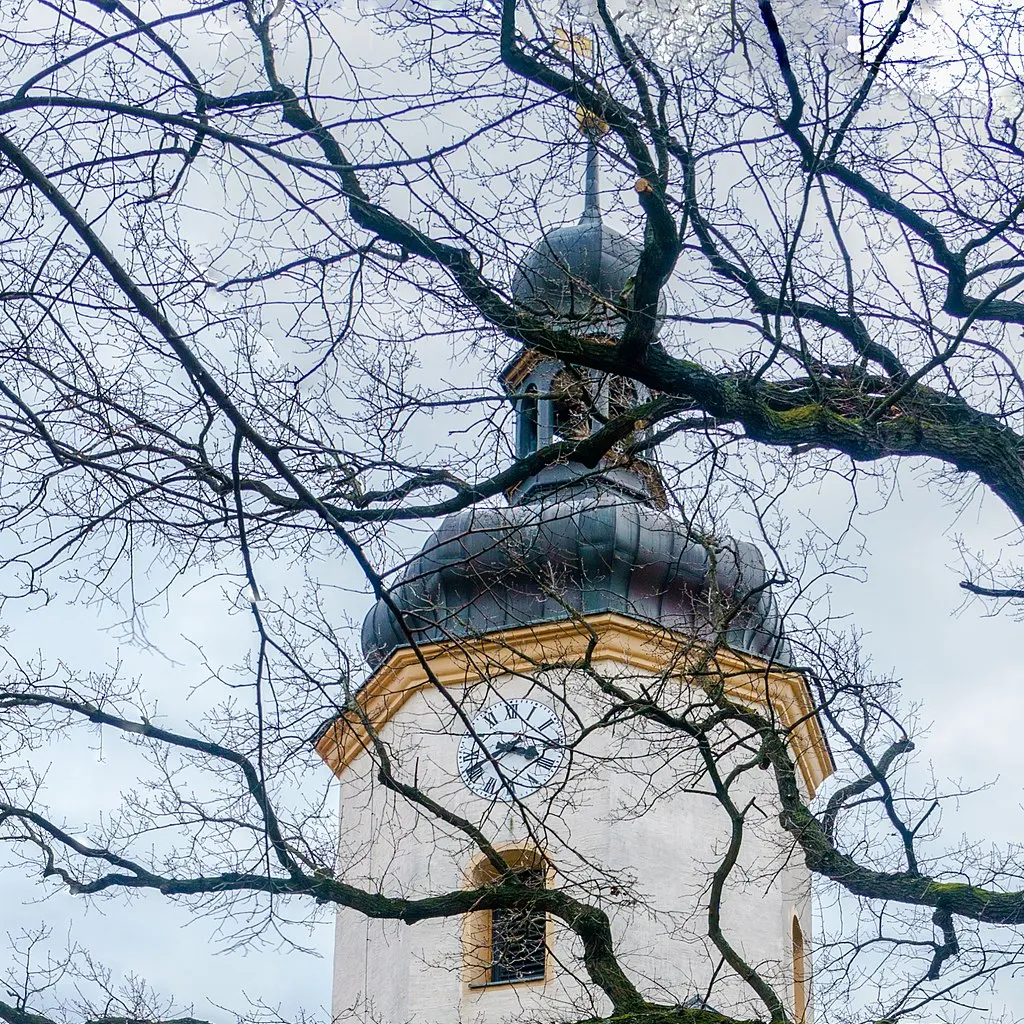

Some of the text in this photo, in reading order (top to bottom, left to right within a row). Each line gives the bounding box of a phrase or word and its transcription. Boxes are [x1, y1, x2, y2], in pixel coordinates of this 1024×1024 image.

[504, 704, 519, 720] XII
[526, 706, 537, 721] I
[483, 712, 499, 729] XI
[538, 718, 554, 731] II
